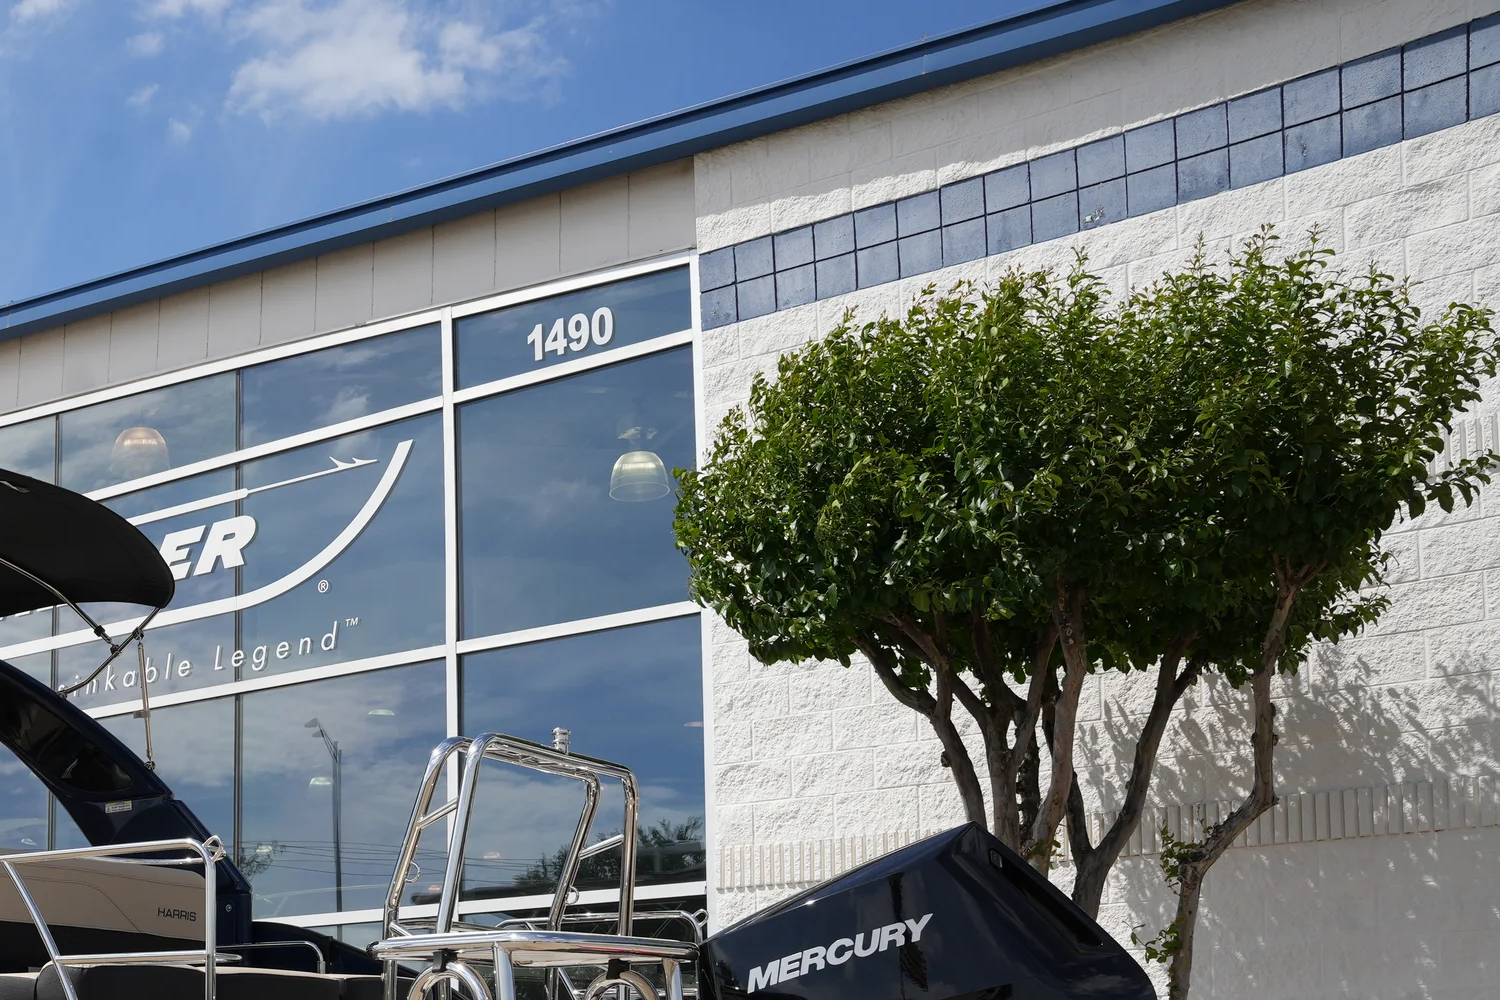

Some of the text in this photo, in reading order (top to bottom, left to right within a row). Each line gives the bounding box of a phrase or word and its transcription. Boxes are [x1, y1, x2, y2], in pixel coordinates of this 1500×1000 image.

[527, 306, 613, 361] 1490
[214, 620, 338, 671] Legend
[157, 907, 197, 921] HARRIS
[747, 912, 933, 994] MERCURY
